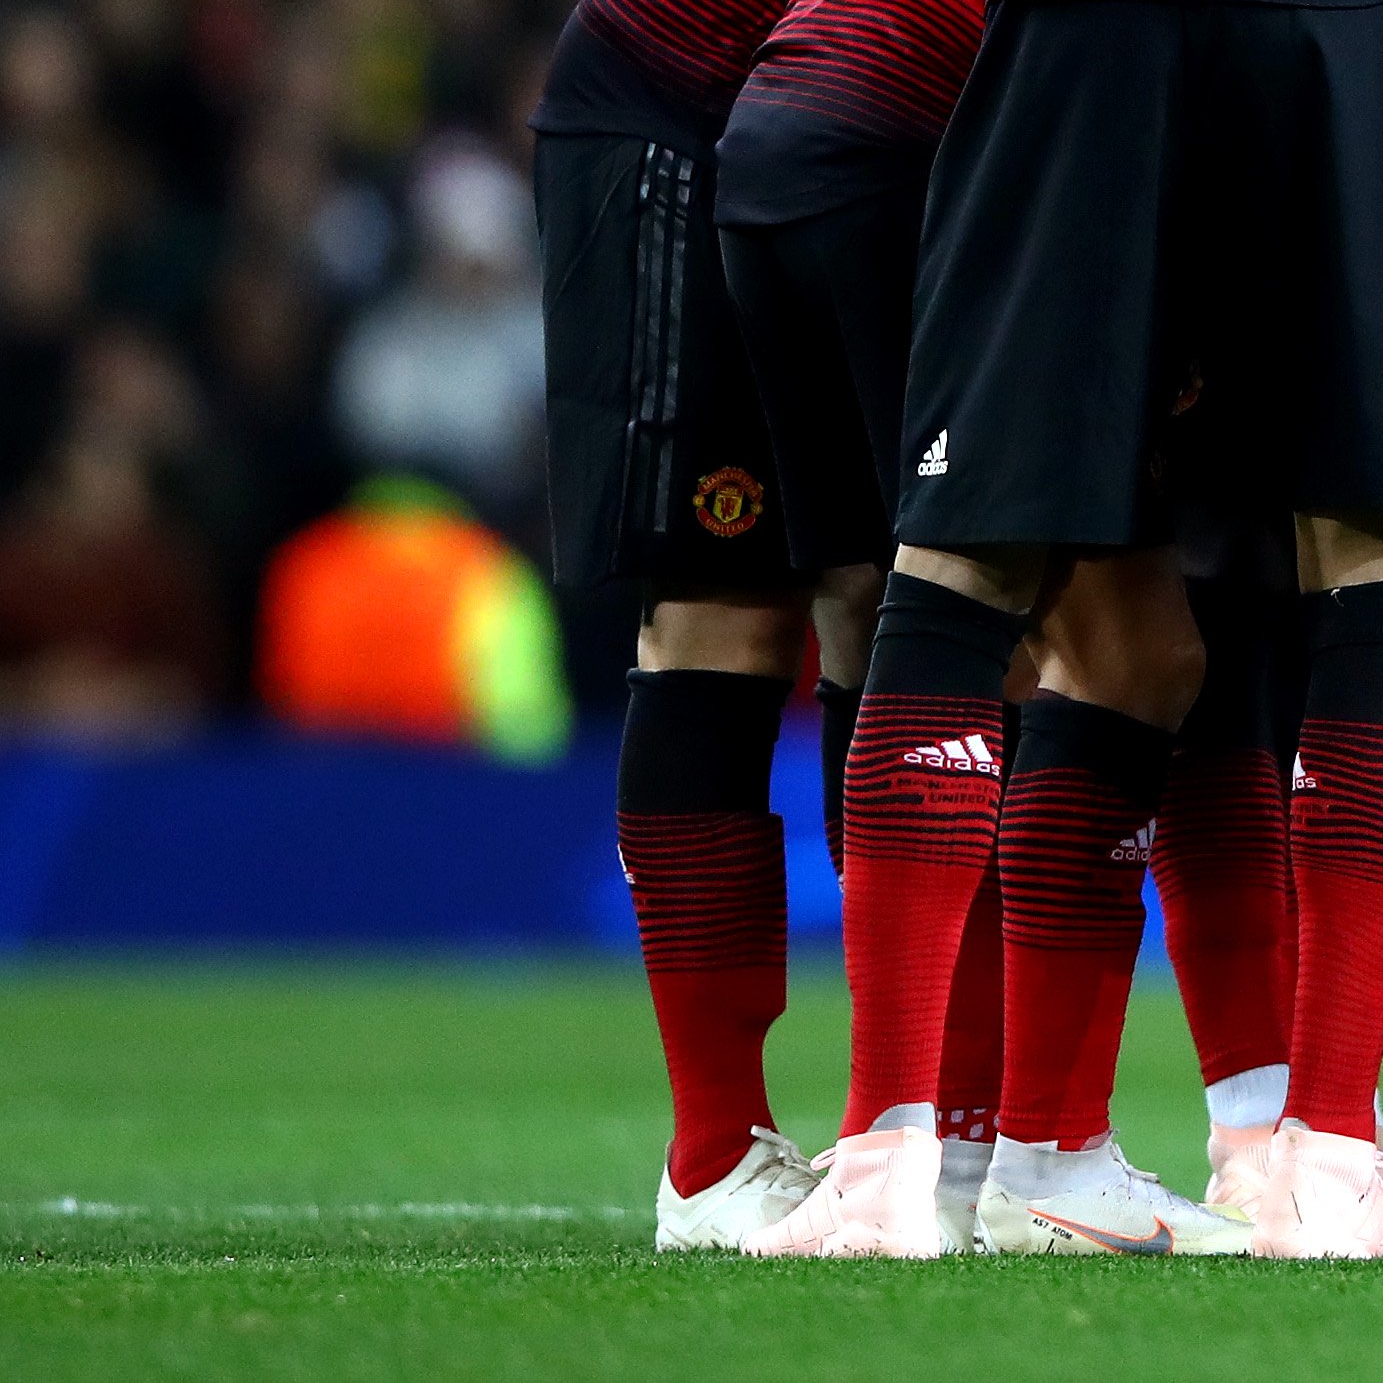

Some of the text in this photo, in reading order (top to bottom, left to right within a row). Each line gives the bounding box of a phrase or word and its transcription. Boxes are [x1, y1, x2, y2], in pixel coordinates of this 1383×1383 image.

[903, 753, 1001, 777] adidas
[1110, 845, 1152, 862] adid
[1051, 1226, 1073, 1241] ATOM
